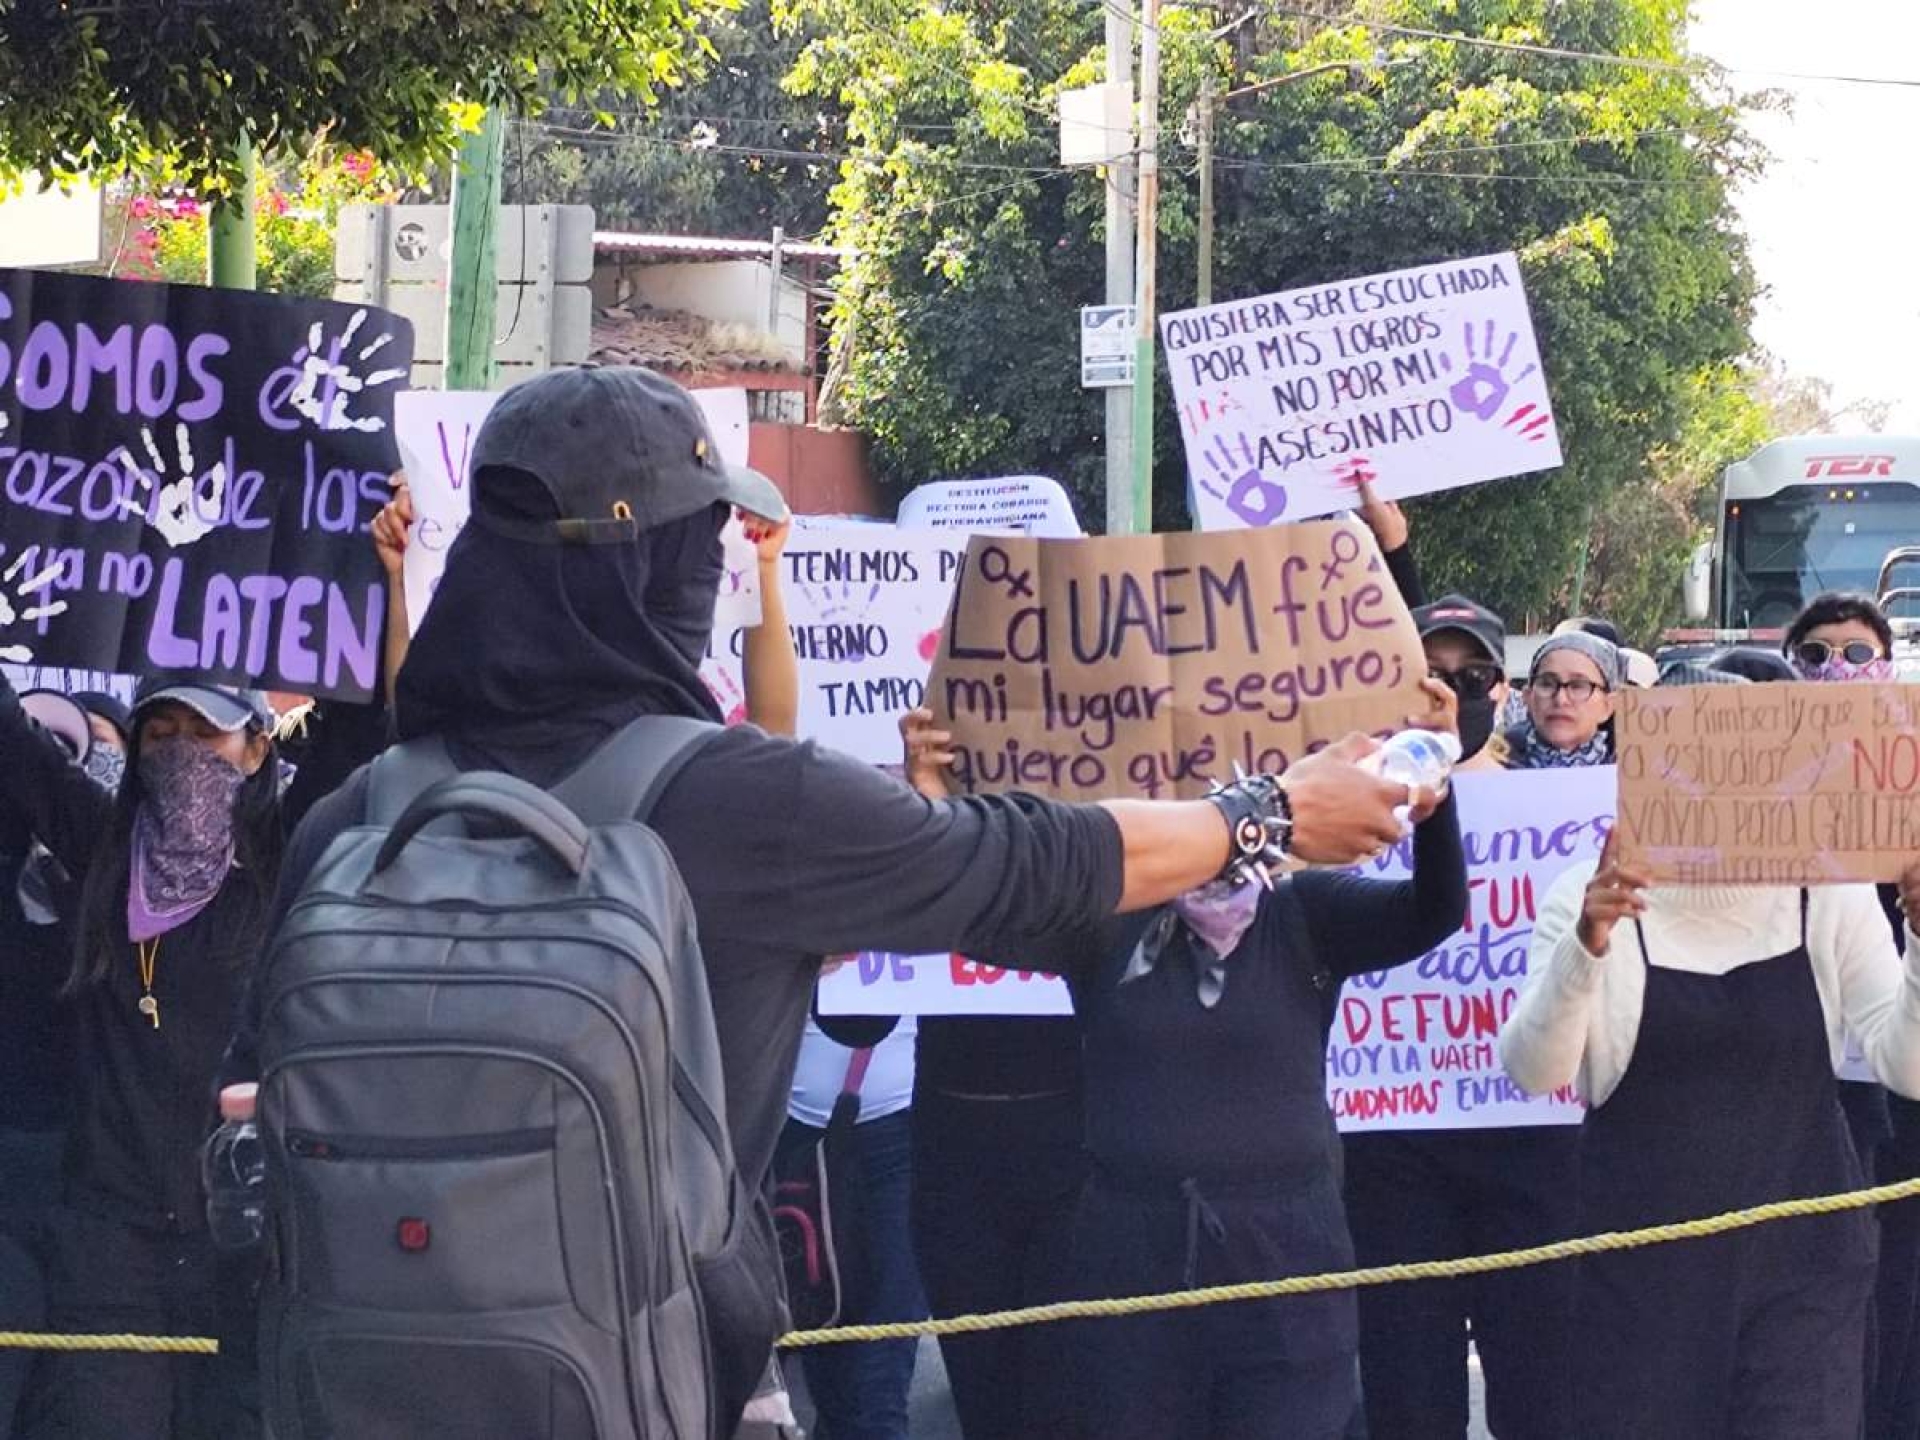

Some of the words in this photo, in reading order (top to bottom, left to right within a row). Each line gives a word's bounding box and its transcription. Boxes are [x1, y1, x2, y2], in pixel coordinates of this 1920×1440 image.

[1166, 301, 1292, 351] QUISIERA
[1293, 286, 1346, 322] SER
[1191, 338, 1250, 387] POR
[1257, 330, 1321, 373] MIS
[1337, 311, 1441, 357] LOGROS
[1272, 378, 1319, 418] NO
[1329, 363, 1387, 406] POR
[1399, 348, 1438, 388] MI
[1256, 397, 1453, 471] ASESINATO
[301, 440, 392, 534] las
[782, 548, 919, 583] TENEMOS
[98, 551, 153, 599] no
[147, 557, 384, 690] LATEN
[948, 551, 1048, 665] La
[1068, 559, 1260, 665] UAEM
[945, 672, 1008, 722] mi
[1043, 668, 1174, 749] lugar
[1199, 650, 1403, 722] seguro;
[1620, 692, 1673, 736] Por
[946, 738, 1106, 799] quiero
[1244, 730, 1288, 776] lo
[1621, 744, 1645, 780] a
[1852, 735, 1920, 792] NO
[1416, 922, 1533, 986] acta
[1326, 1044, 1383, 1078] HOY
[1390, 1044, 1422, 1075] LA
[1430, 1041, 1494, 1072] UAEM
